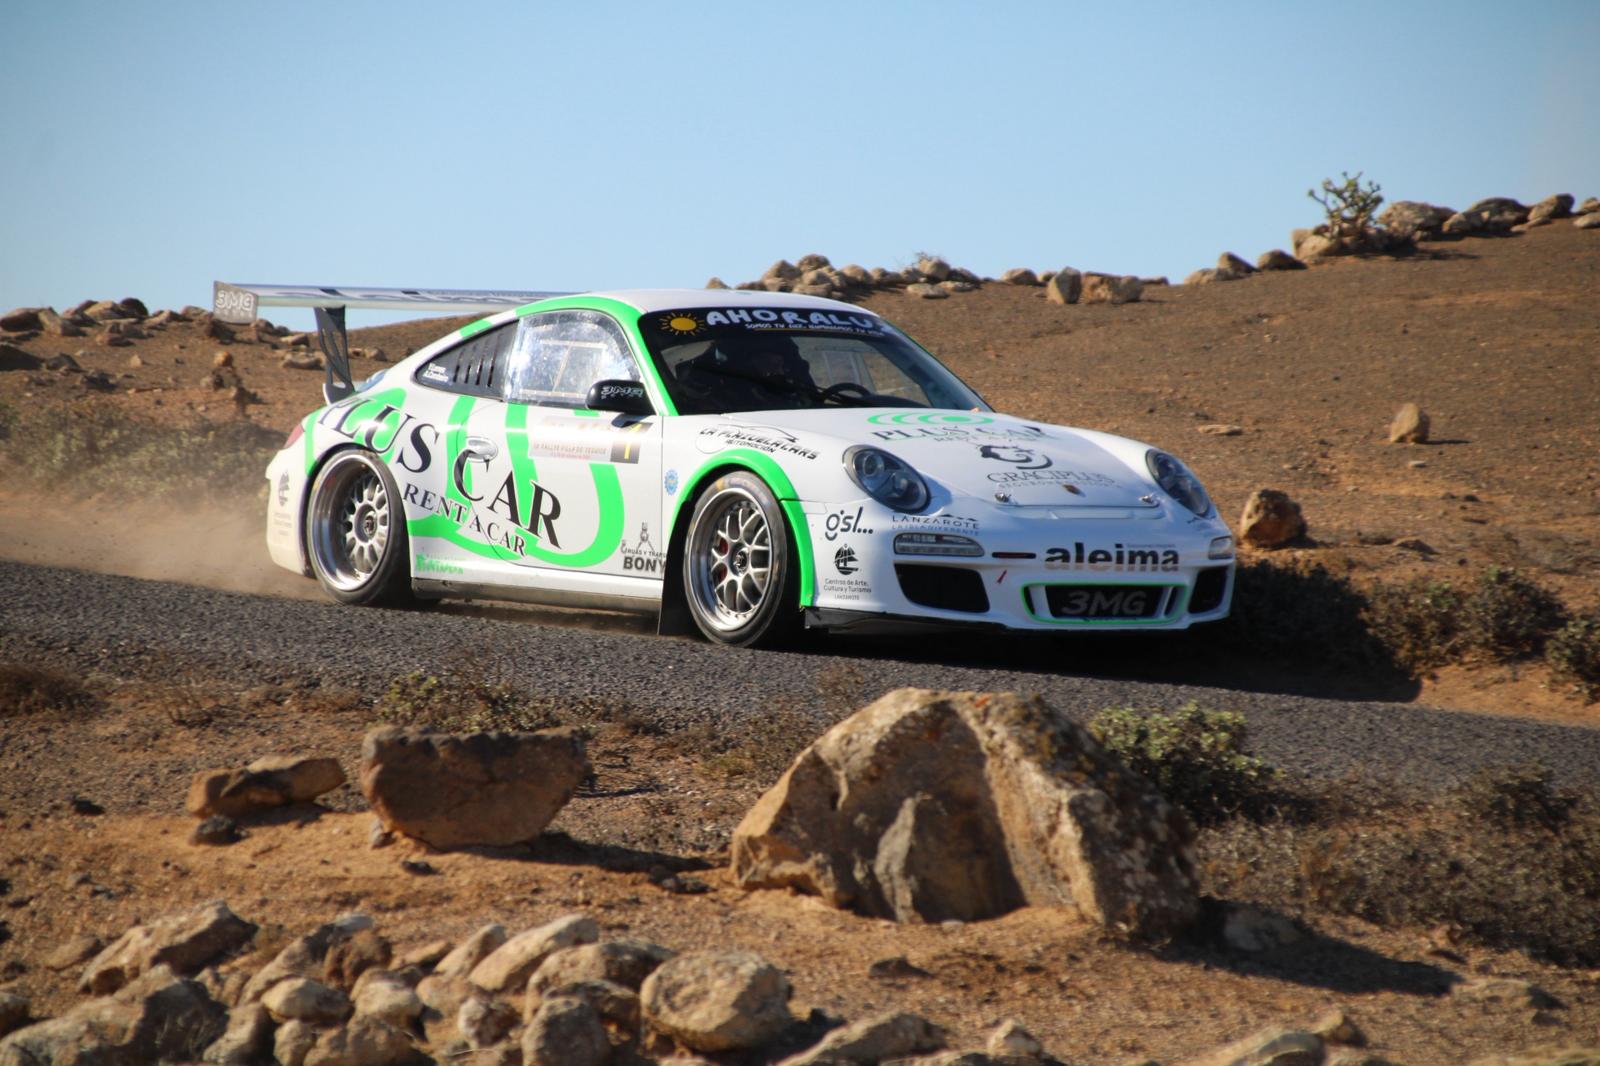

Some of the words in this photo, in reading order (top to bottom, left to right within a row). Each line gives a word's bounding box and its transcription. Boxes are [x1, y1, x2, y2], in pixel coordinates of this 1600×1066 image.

[872, 425, 970, 441] PLUS
[454, 449, 562, 550] CAR
[403, 483, 467, 524] RENT
[469, 515, 482, 533] A
[487, 522, 527, 556] CAR
[892, 515, 980, 529] LANZAROTE
[1044, 541, 1180, 572] aleima
[1060, 590, 1147, 616] 3MG
